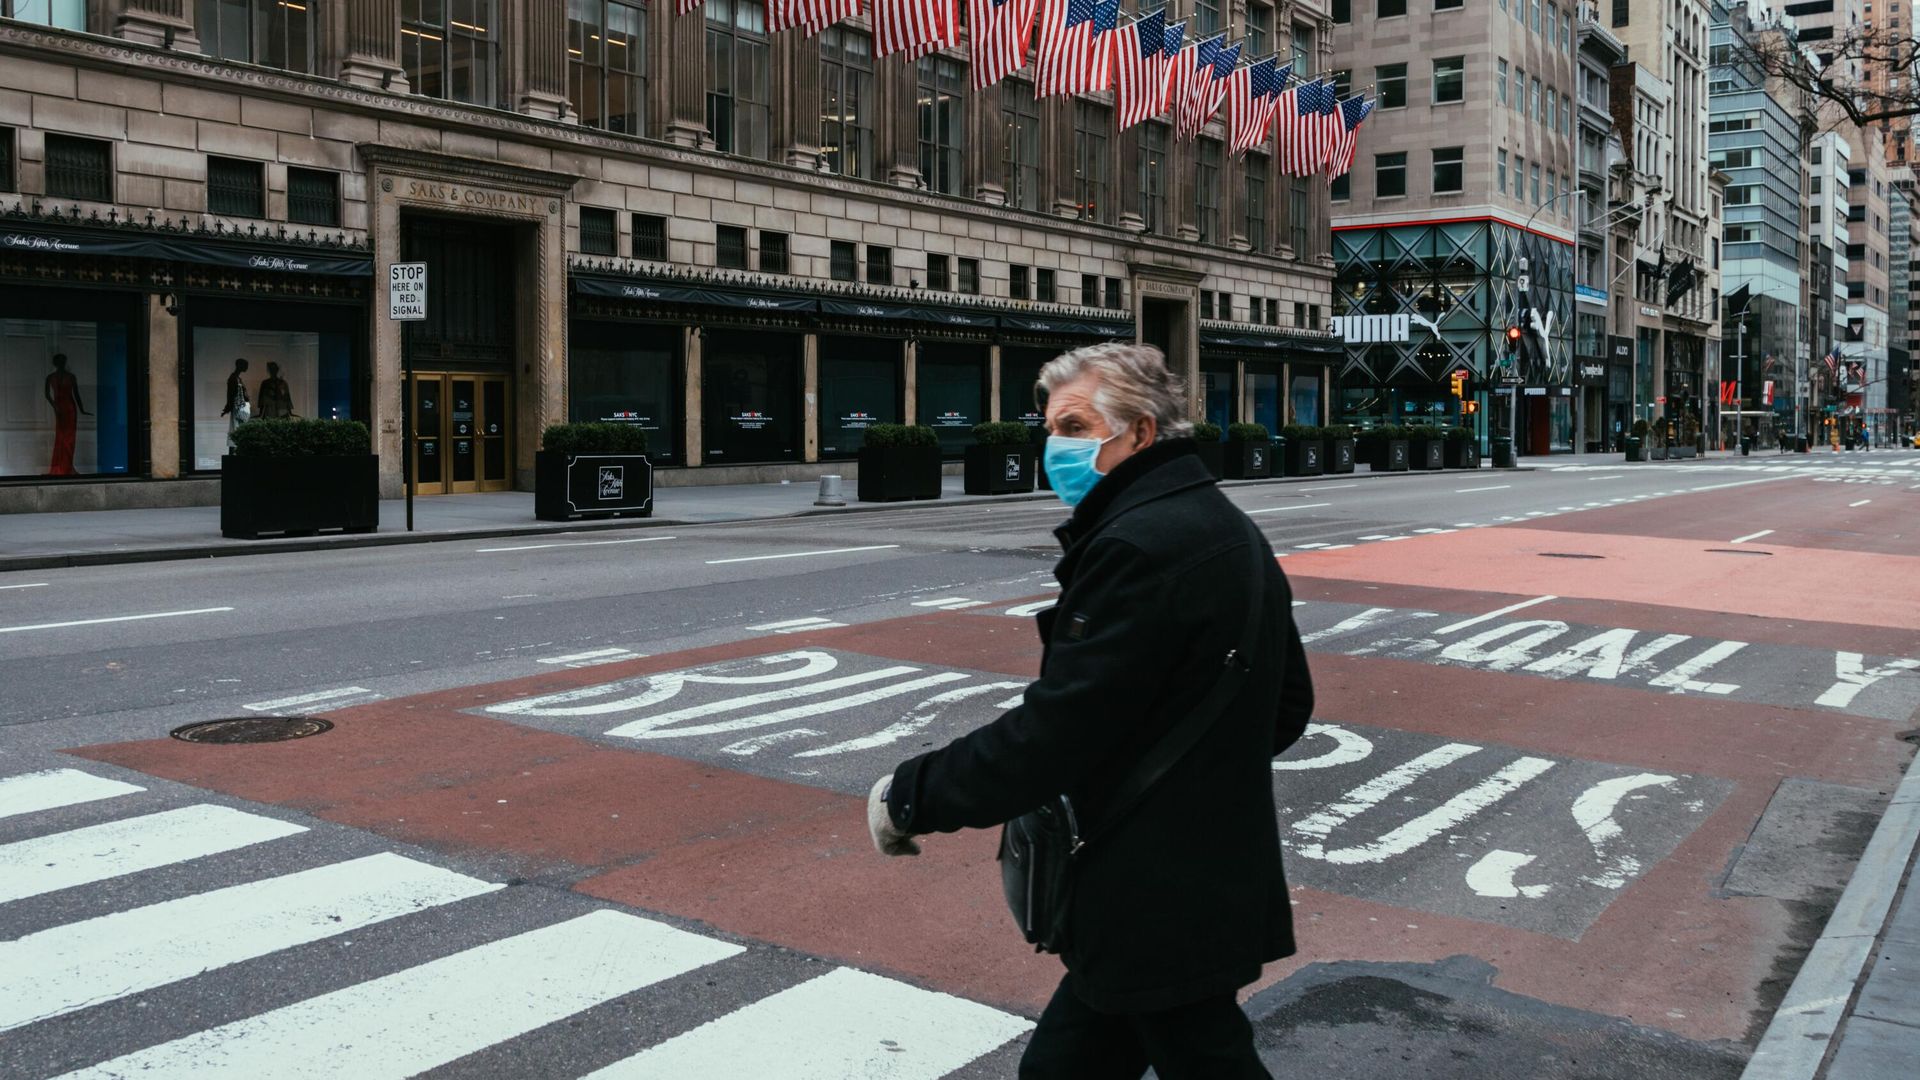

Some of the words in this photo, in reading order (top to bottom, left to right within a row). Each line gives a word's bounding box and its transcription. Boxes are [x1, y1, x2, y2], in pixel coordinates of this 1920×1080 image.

[410, 181, 446, 200] SAKS
[450, 187, 458, 200] &
[464, 189, 537, 214] COMPANY
[3, 233, 30, 247] Saks
[26, 235, 49, 248] Fifth
[47, 238, 80, 250] Avenue
[248, 255, 270, 267] Saks
[283, 258, 309, 270] Avenue
[392, 266, 424, 280] STOP
[392, 282, 411, 292] HERE
[413, 282, 424, 291] ON
[399, 294, 416, 303] RED
[392, 305, 423, 315] SIGNAL
[1330, 313, 1409, 342] PUMA
[1616, 345, 1628, 355] ALDO
[1440, 619, 1920, 708] ONLY
[485, 650, 1034, 758] BUS
